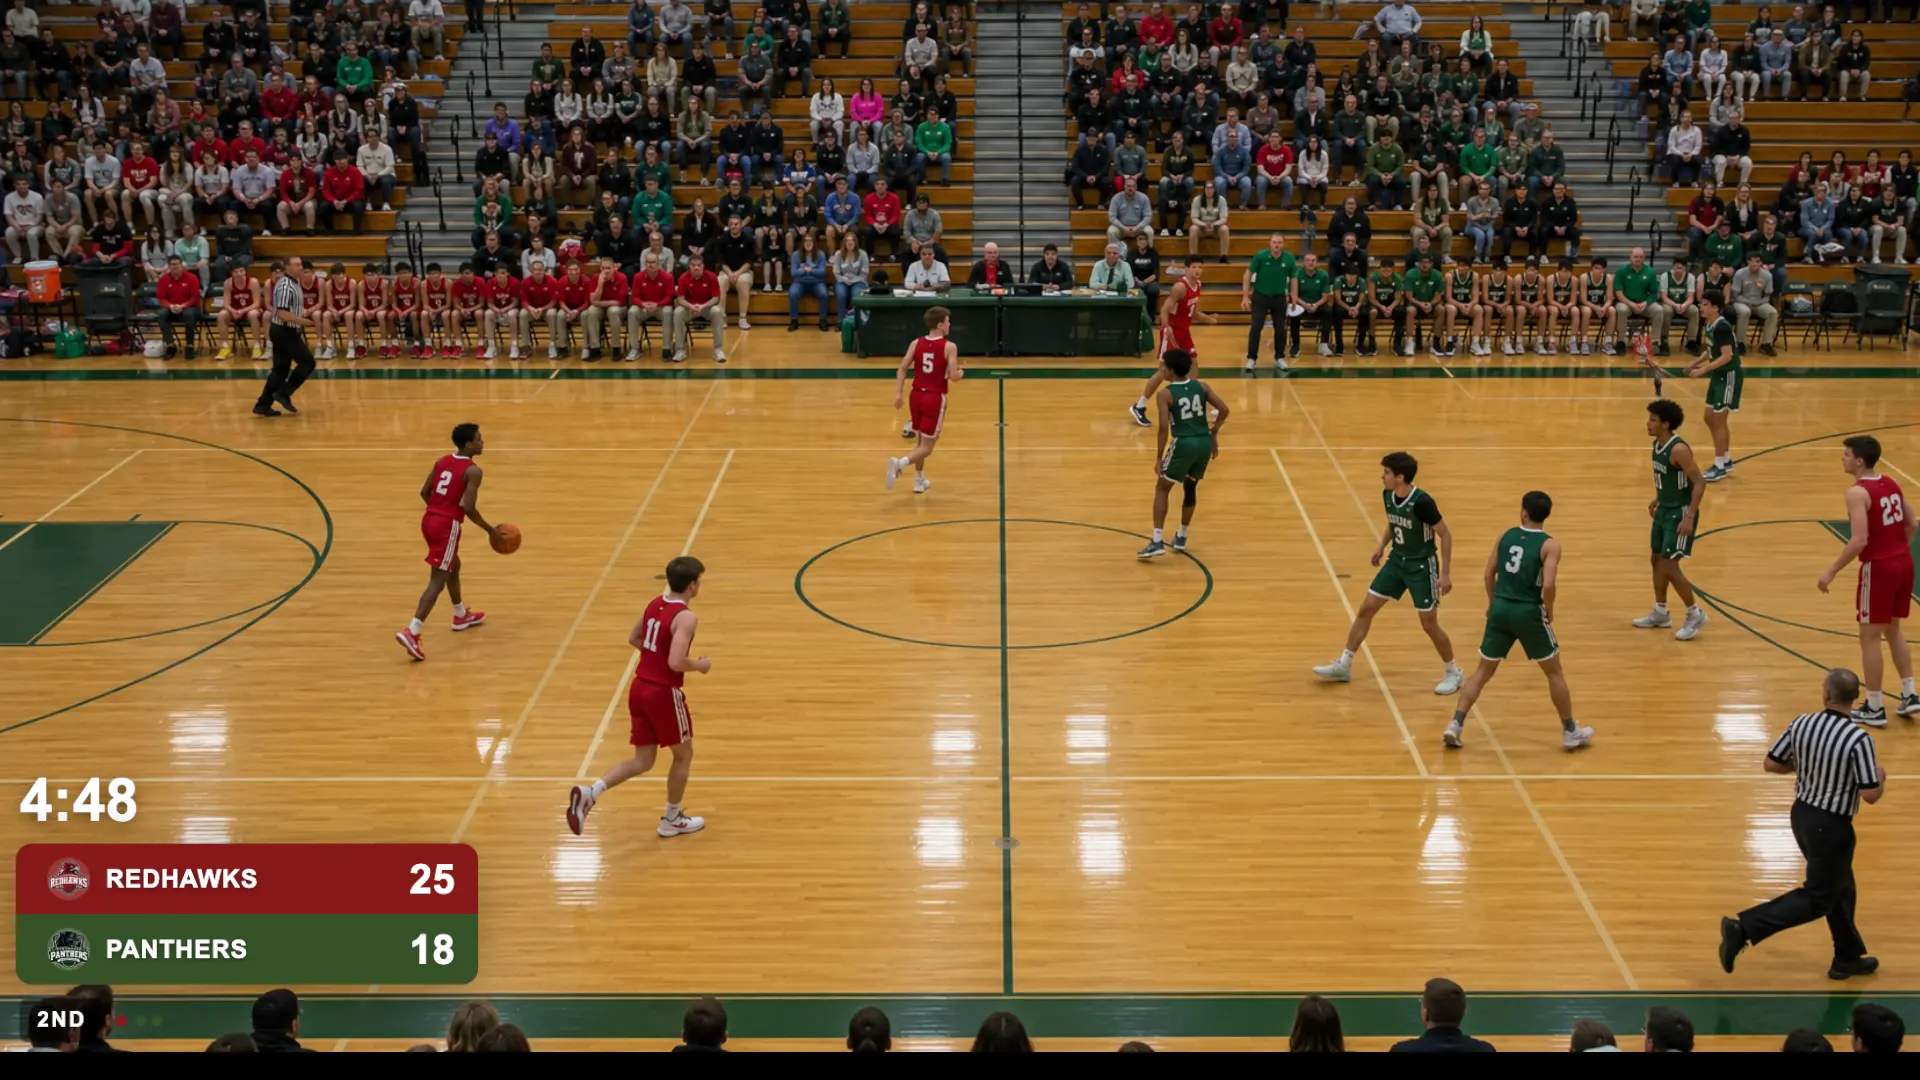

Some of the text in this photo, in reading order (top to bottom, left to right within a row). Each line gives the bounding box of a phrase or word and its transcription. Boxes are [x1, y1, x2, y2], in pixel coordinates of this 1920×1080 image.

[922, 352, 934, 374] 5
[1178, 394, 1205, 420] 24
[435, 470, 453, 495] 2
[1880, 493, 1903, 526] 23
[1393, 526, 1405, 545] 3
[1505, 545, 1524, 574] 3
[643, 617, 661, 652] 11
